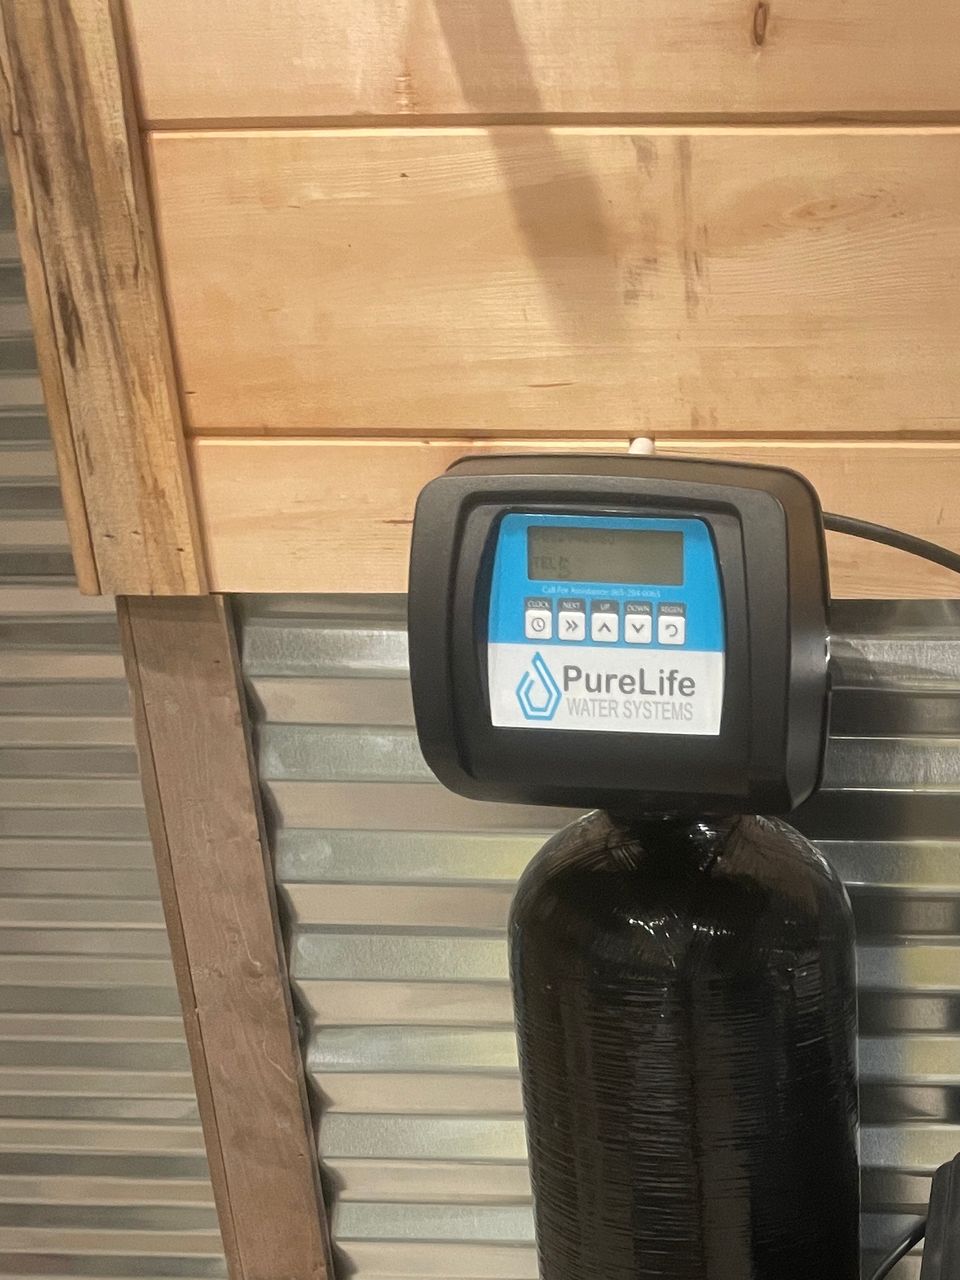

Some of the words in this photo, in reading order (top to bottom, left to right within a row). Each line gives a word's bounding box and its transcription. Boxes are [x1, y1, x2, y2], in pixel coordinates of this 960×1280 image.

[527, 600, 550, 608] CLOCK
[562, 601, 581, 609] NEXT
[627, 604, 650, 612] DOWN
[660, 606, 683, 614] REGEN
[563, 665, 696, 697] PureLife
[567, 698, 618, 718] WATER
[622, 700, 693, 721] SYSTEMS
